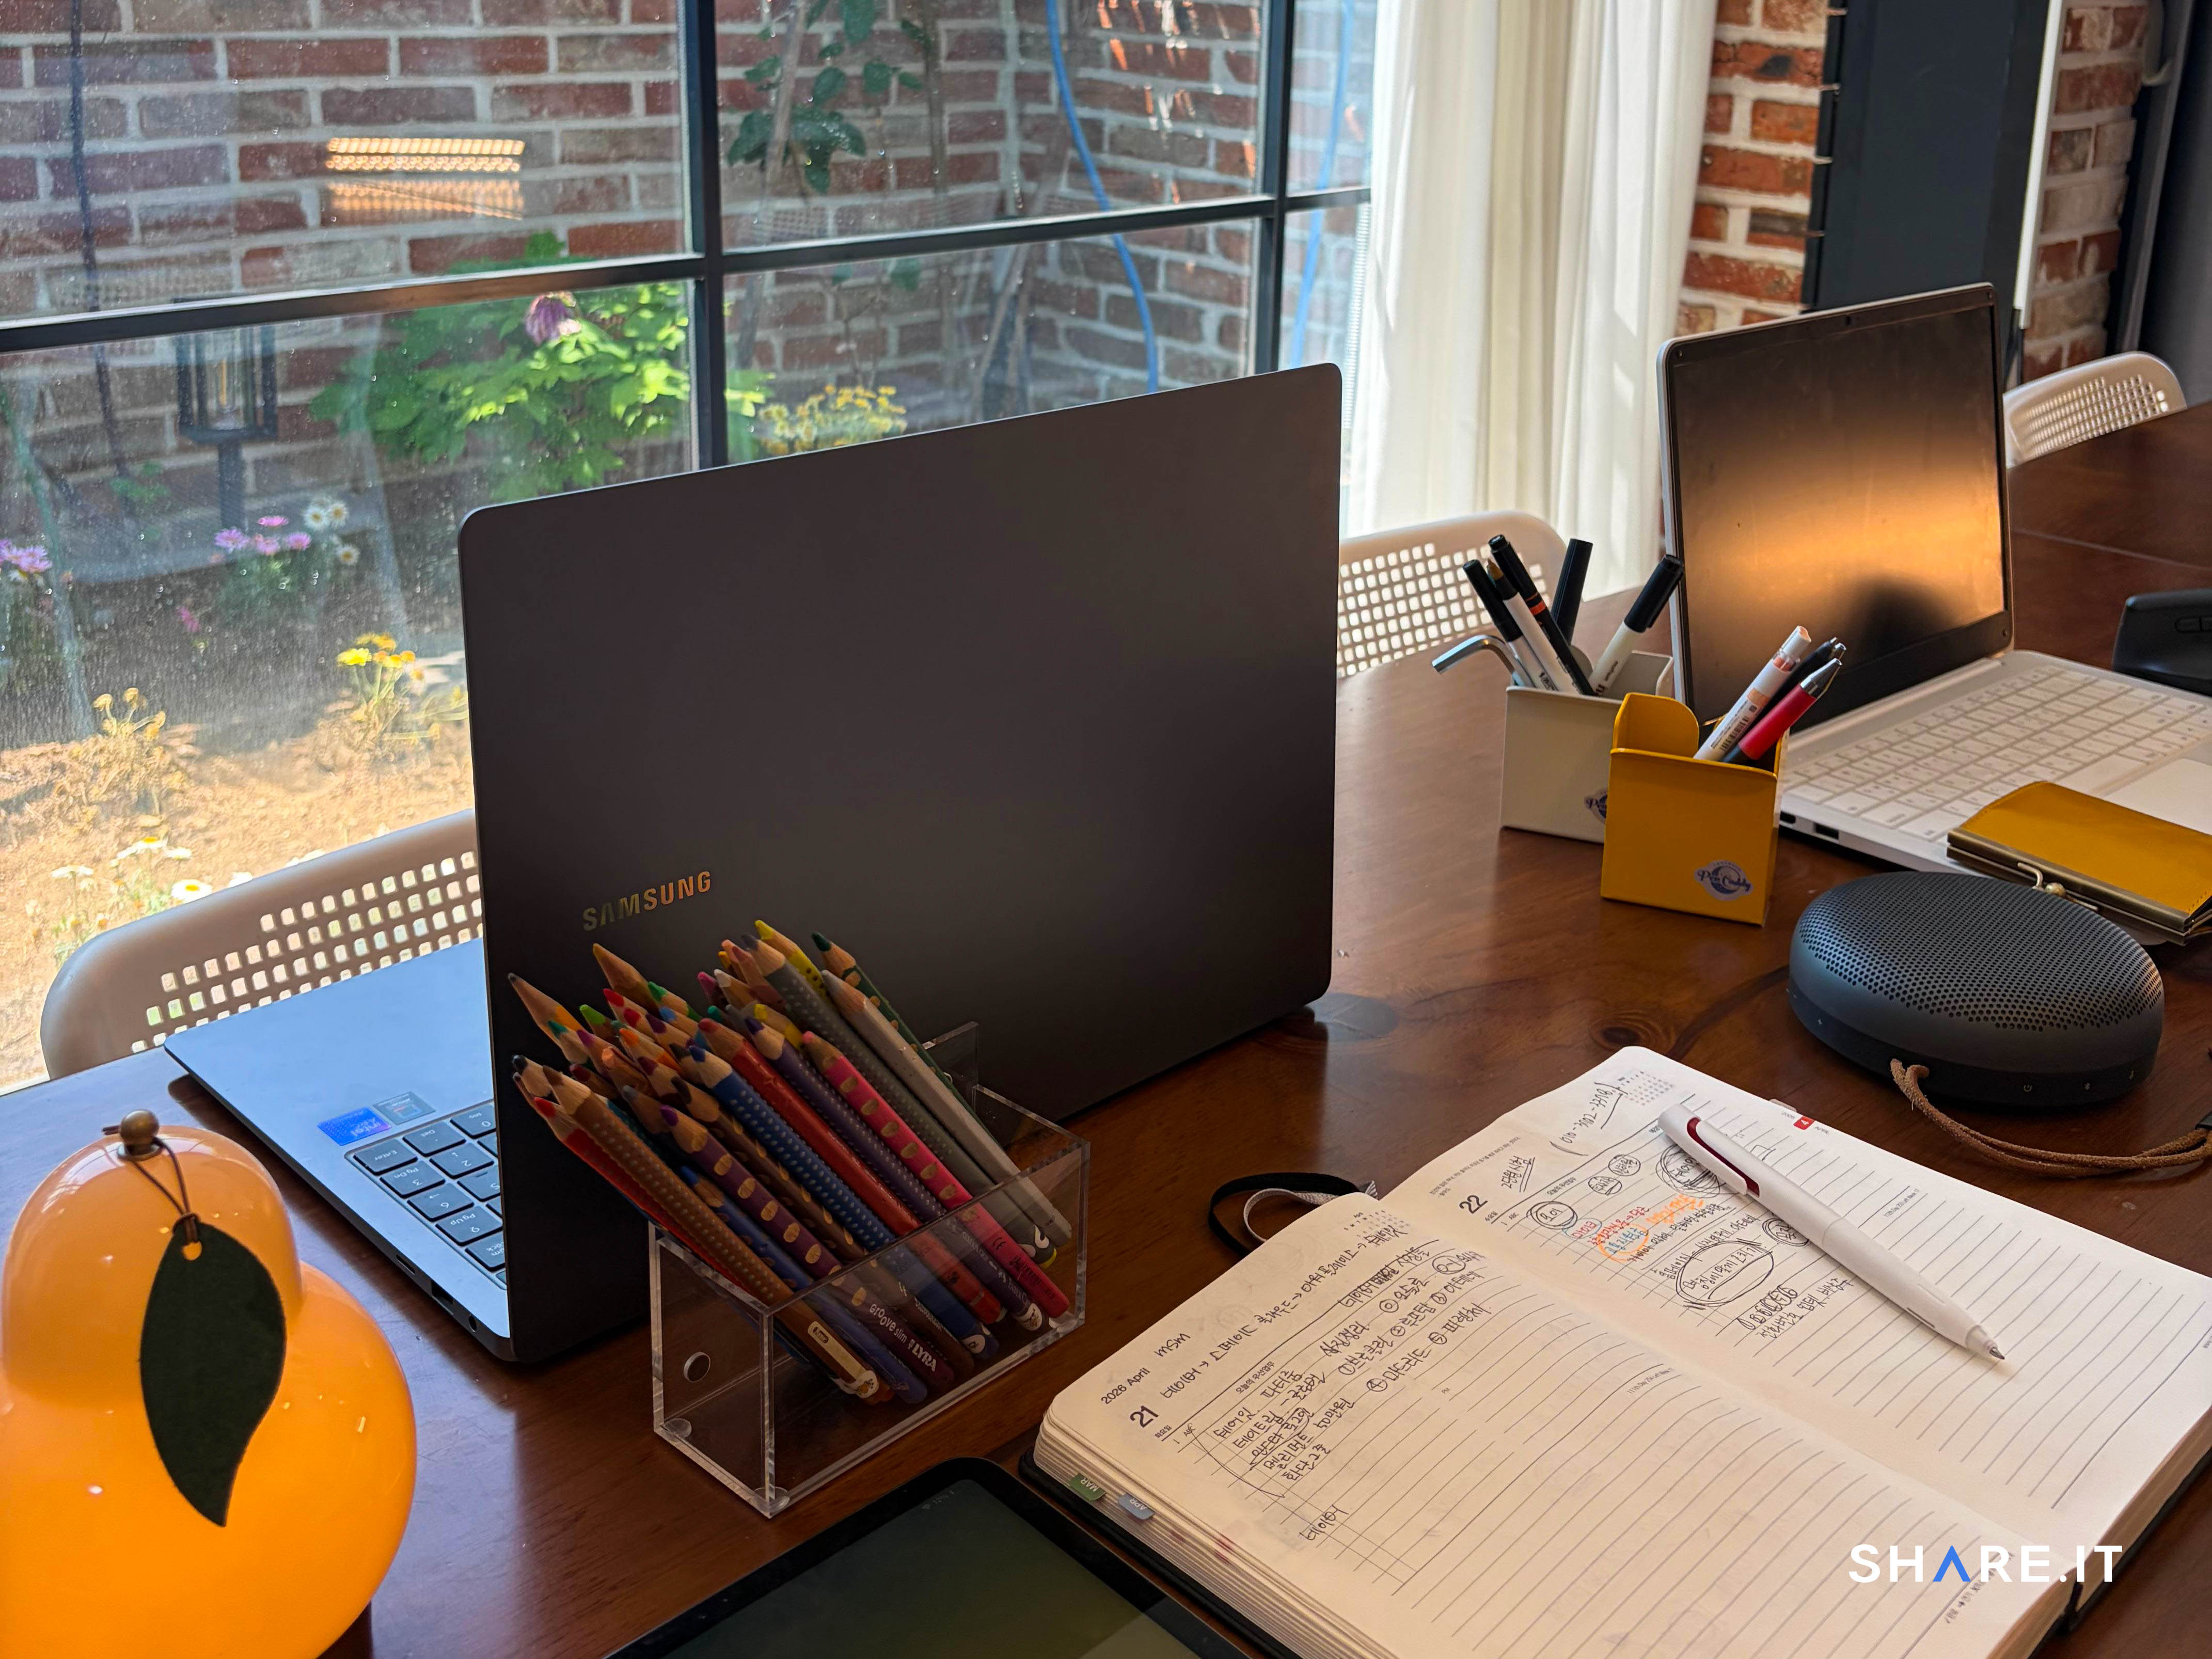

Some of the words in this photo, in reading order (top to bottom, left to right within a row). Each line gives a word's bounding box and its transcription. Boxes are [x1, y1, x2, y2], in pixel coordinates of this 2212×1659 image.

[582, 871, 712, 931] SAMSUNG
[373, 1150, 398, 1161] Enter
[1459, 1195, 1487, 1213] 22
[894, 1328, 907, 1343] slim
[912, 1344, 937, 1372] LYRA
[1101, 1385, 1127, 1404] 2026
[1127, 1368, 1150, 1386] April
[1236, 1379, 1255, 1394] 오늘의
[1253, 1362, 1274, 1379] 우선업무
[1130, 1405, 1158, 1427] 21
[1080, 1477, 1099, 1492] MAR
[1129, 1498, 1147, 1510] APR
